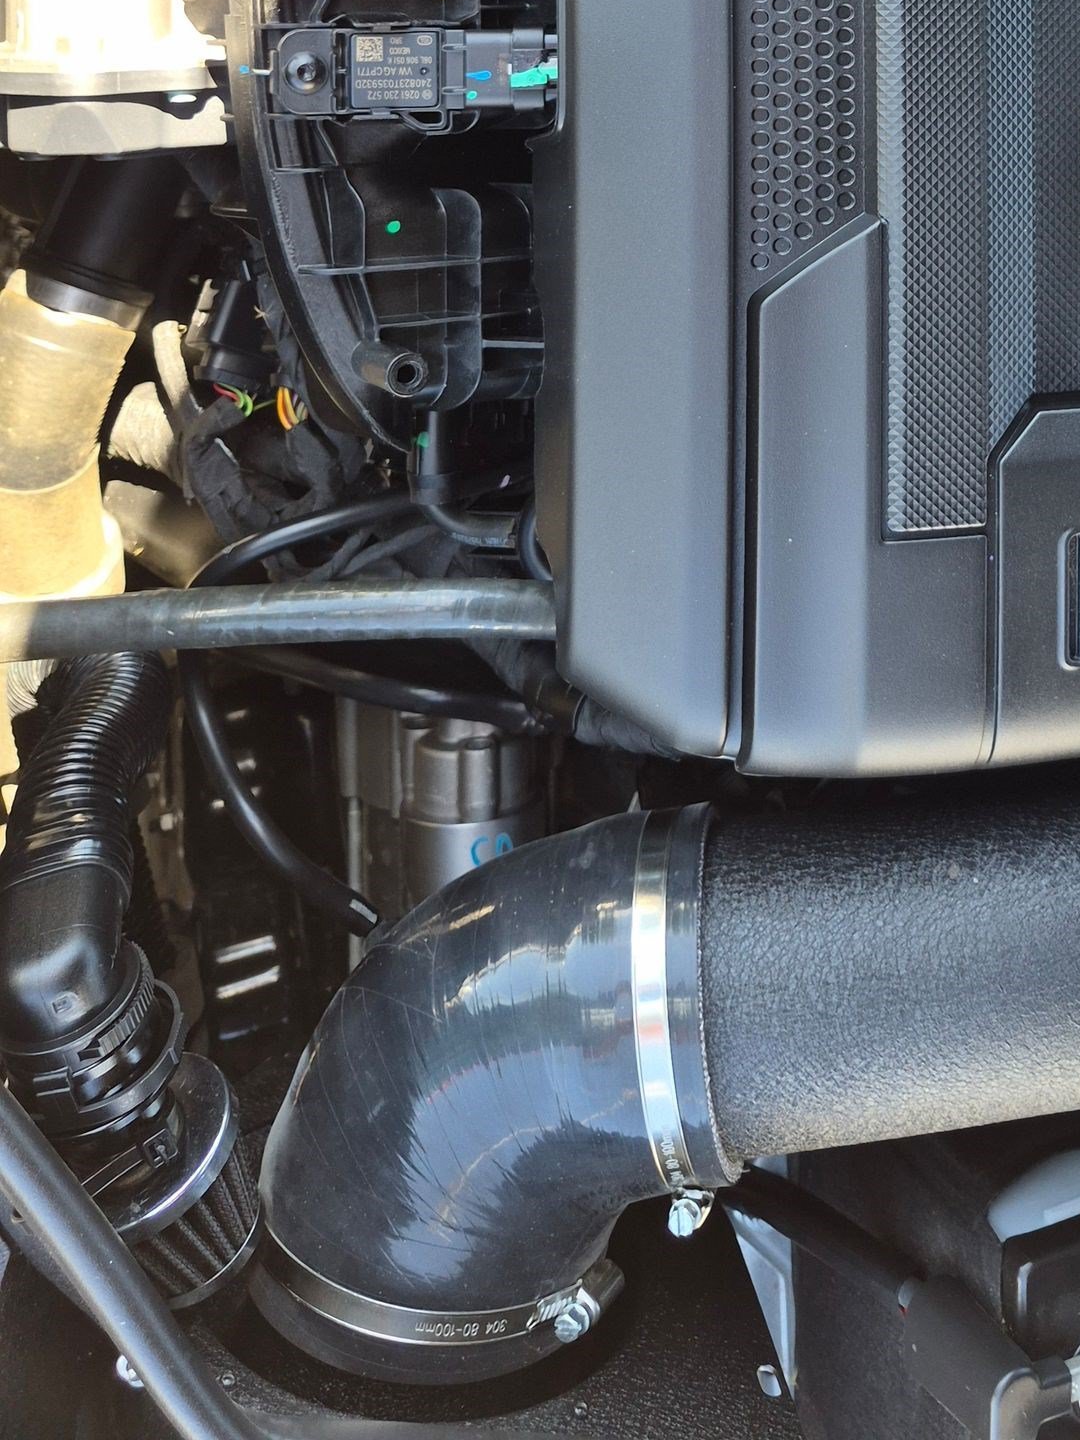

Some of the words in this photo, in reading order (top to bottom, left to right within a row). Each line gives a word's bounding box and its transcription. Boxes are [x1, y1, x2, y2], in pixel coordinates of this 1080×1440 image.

[398, 66, 413, 76] VW
[367, 90, 383, 100] 572
[383, 90, 400, 100] 230
[415, 1322, 480, 1337] 80-100mm
[485, 1319, 508, 1335] 304
